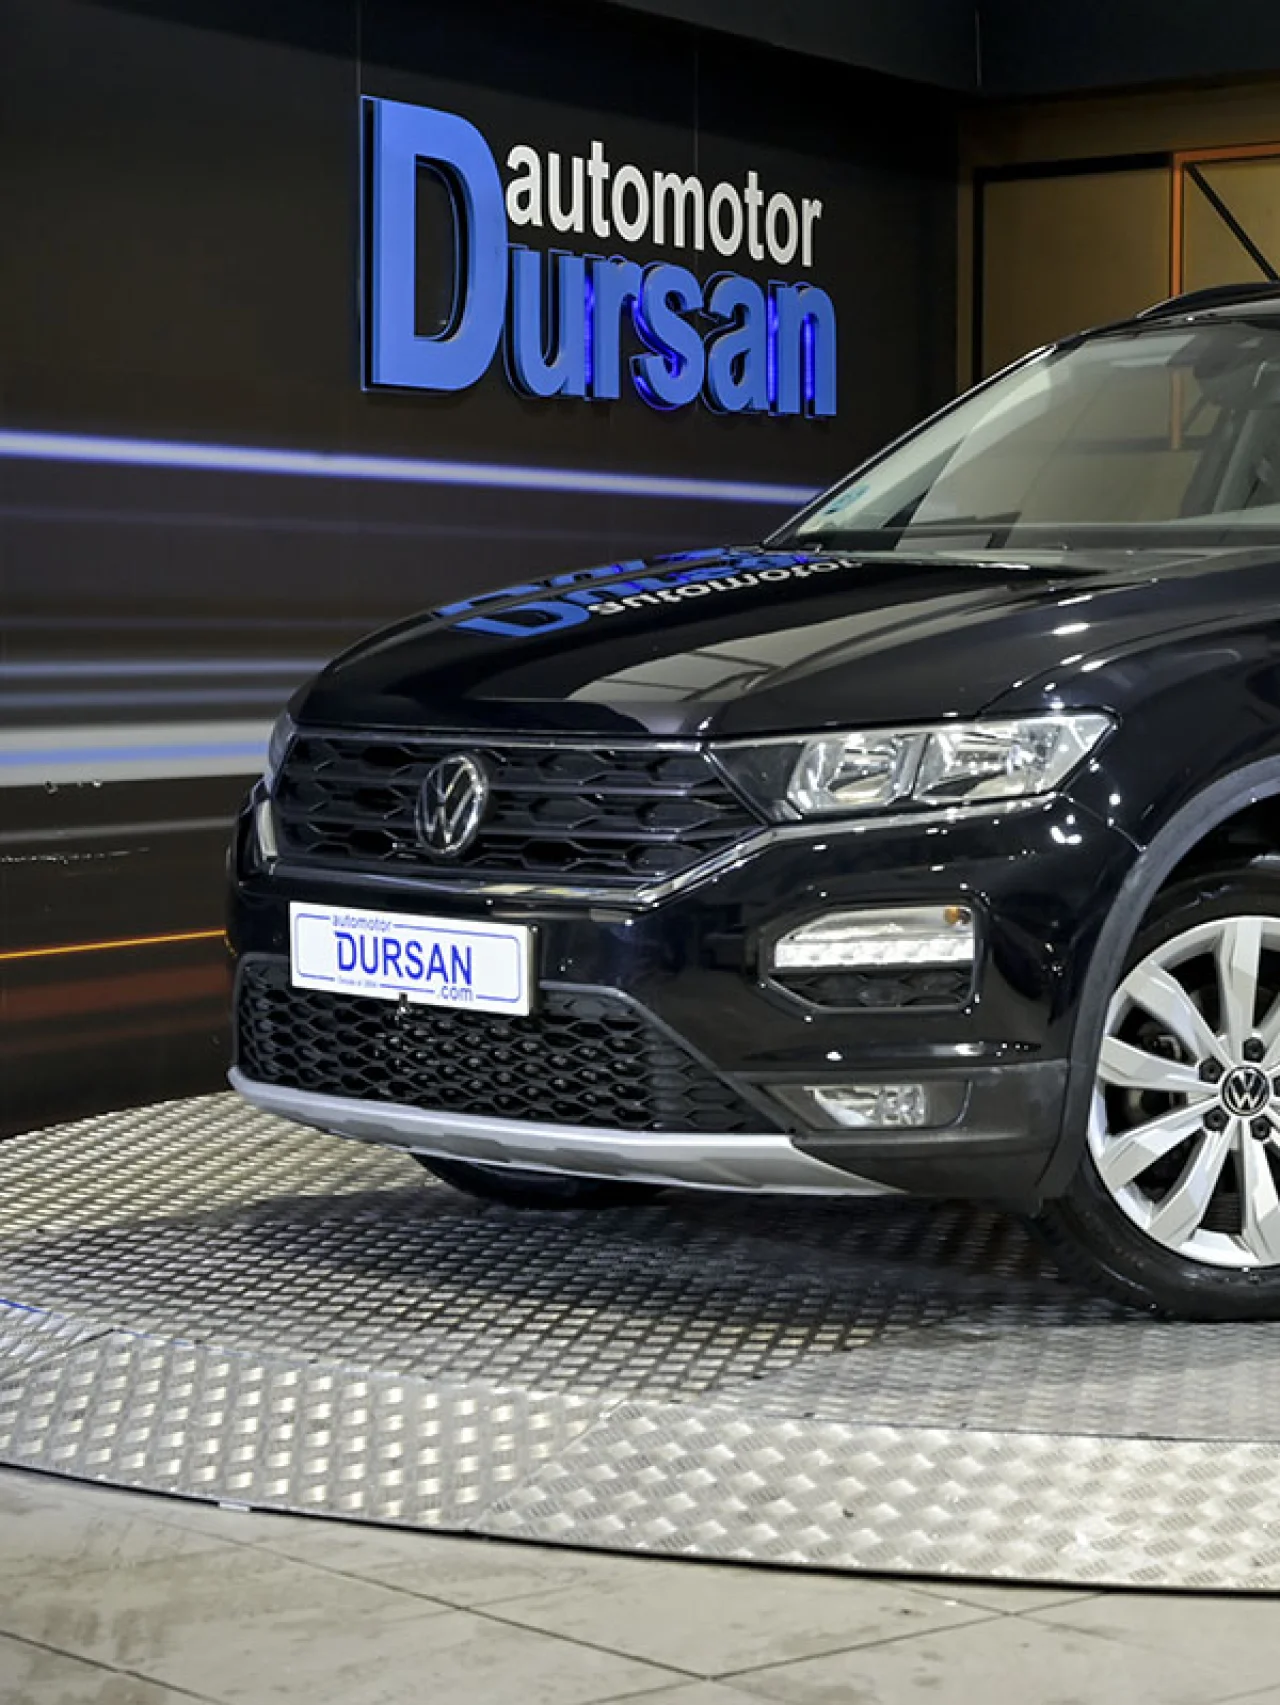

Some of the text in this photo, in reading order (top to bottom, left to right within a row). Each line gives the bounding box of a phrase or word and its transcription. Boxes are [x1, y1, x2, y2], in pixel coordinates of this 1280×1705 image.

[360, 95, 837, 418] Dursan
[506, 140, 822, 267] automotor
[335, 930, 472, 986] DURSAN
